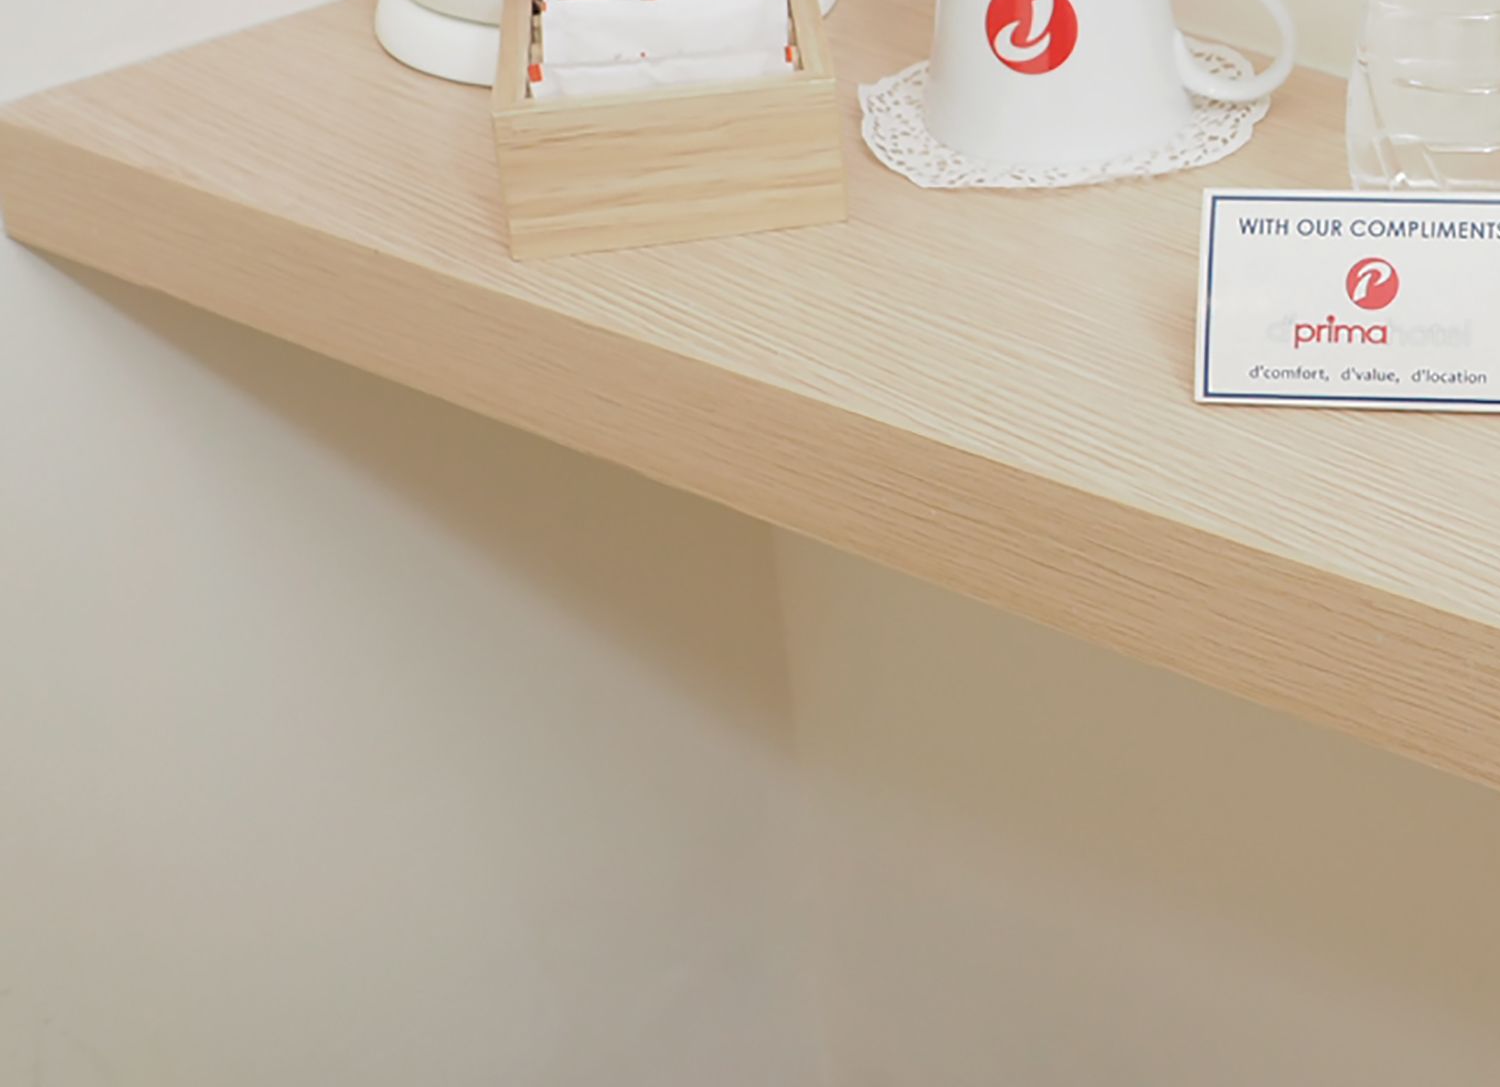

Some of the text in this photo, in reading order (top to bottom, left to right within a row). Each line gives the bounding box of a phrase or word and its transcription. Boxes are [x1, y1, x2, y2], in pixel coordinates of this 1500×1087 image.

[1238, 217, 1289, 237] WITH
[1296, 218, 1342, 238] OUR
[1248, 364, 1488, 385] d'comfort, d'value, d'location
